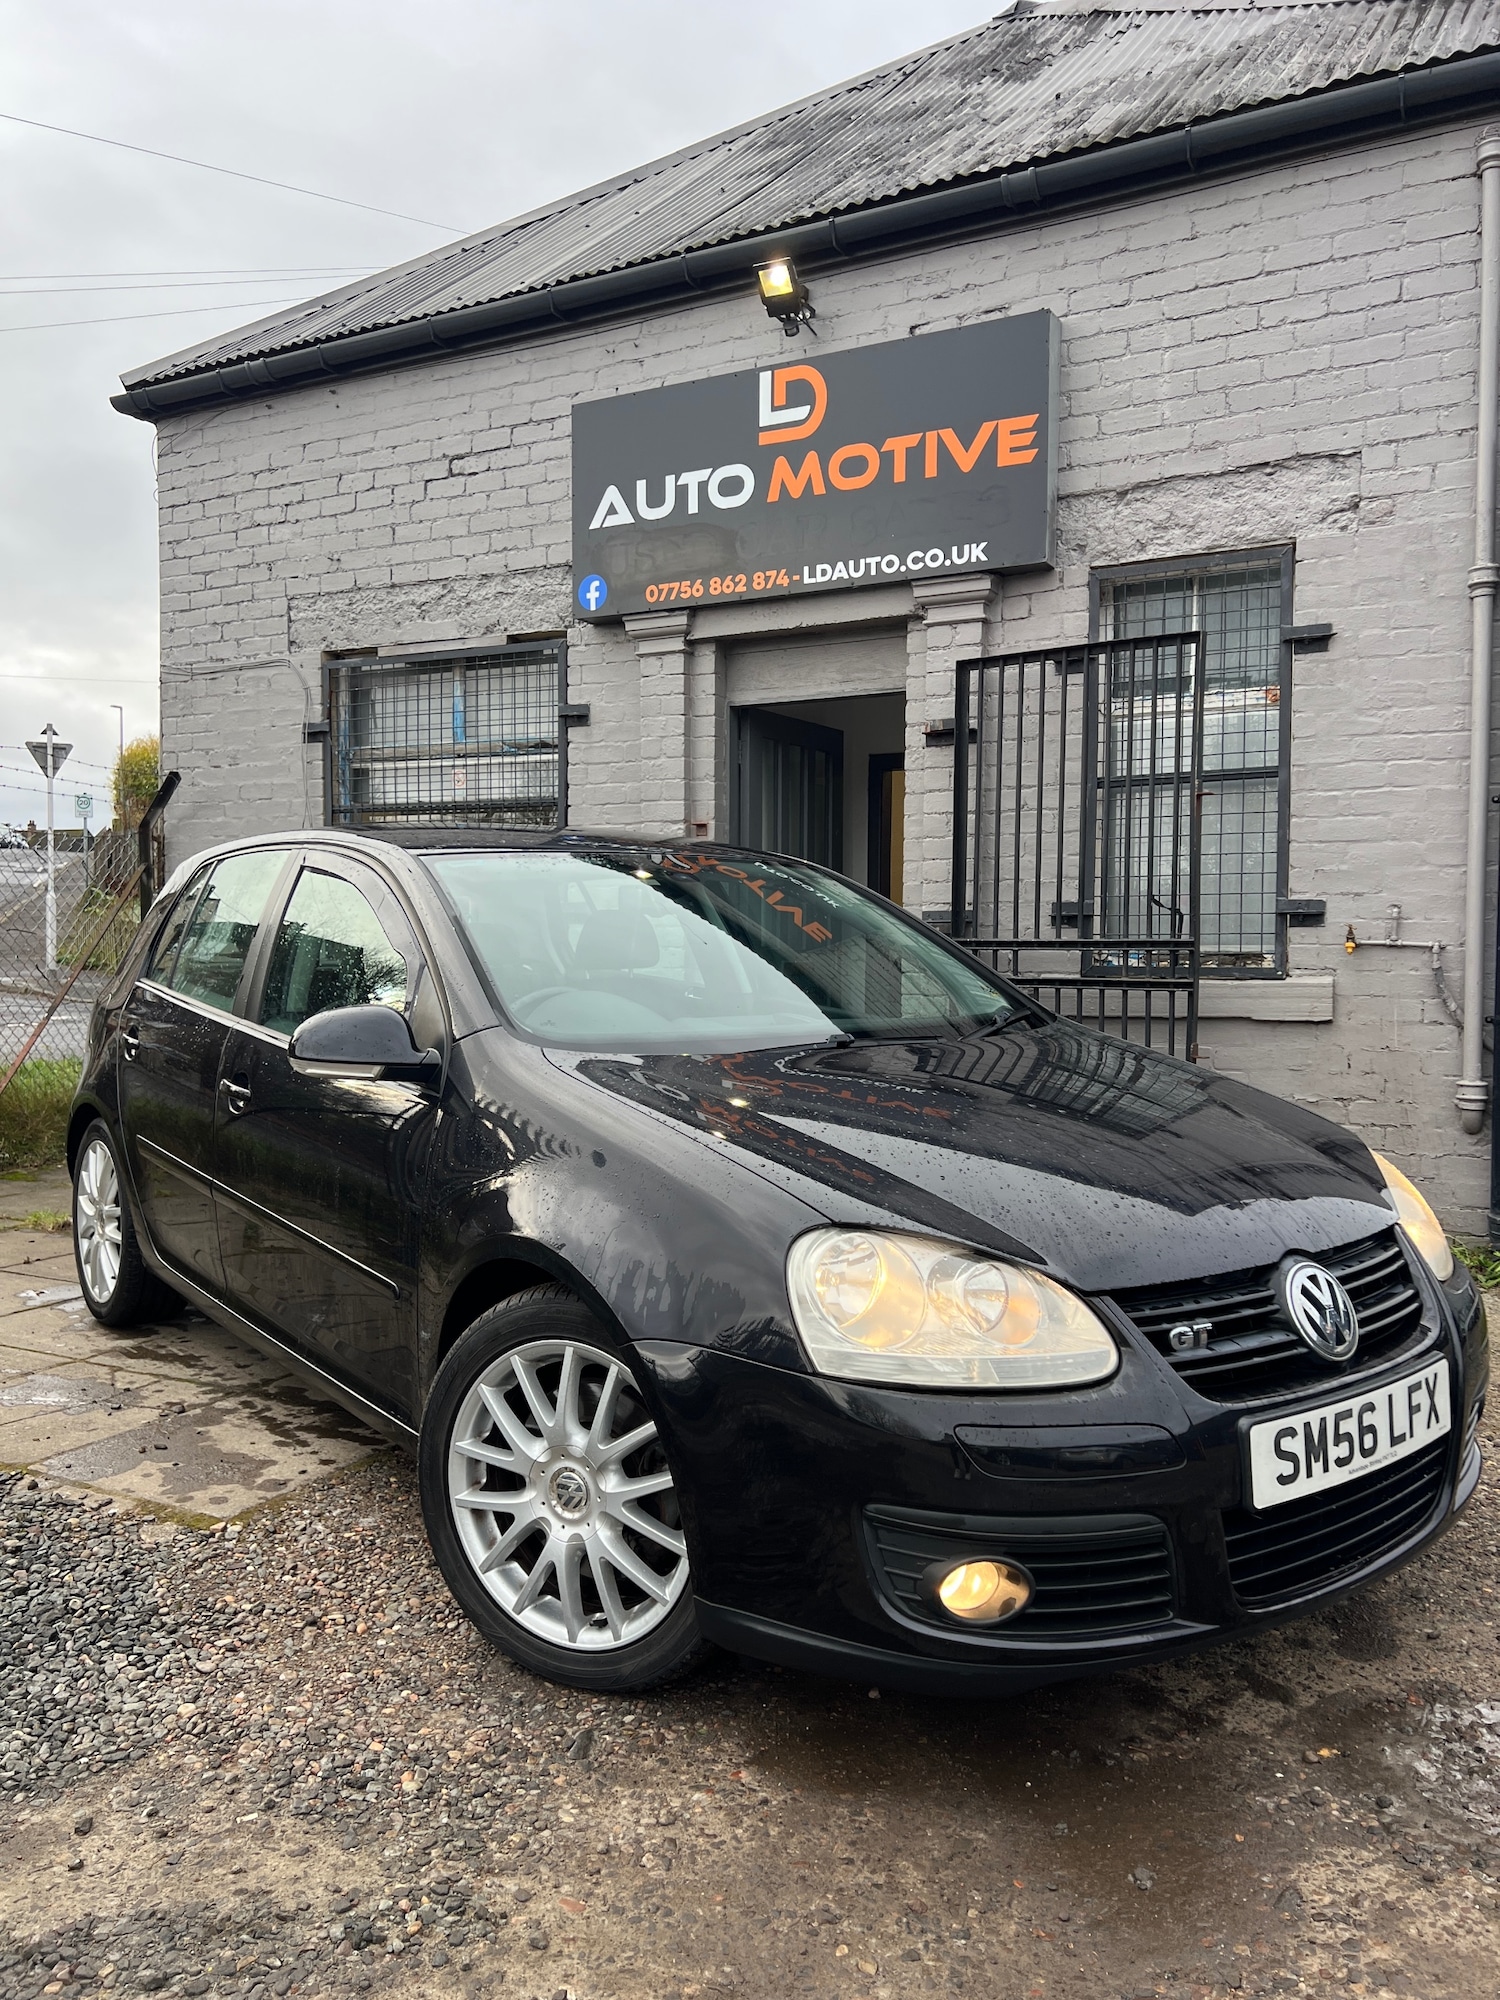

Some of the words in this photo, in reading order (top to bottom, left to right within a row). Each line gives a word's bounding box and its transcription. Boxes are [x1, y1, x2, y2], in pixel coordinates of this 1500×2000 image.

[588, 463, 756, 530] AUTO
[766, 413, 1040, 503] MOTIVE
[645, 579, 703, 603] 07756
[709, 573, 747, 596] 862
[1169, 1322, 1213, 1351] GT
[1273, 1401, 1379, 1487] SM56
[1387, 1372, 1440, 1448] LFX
